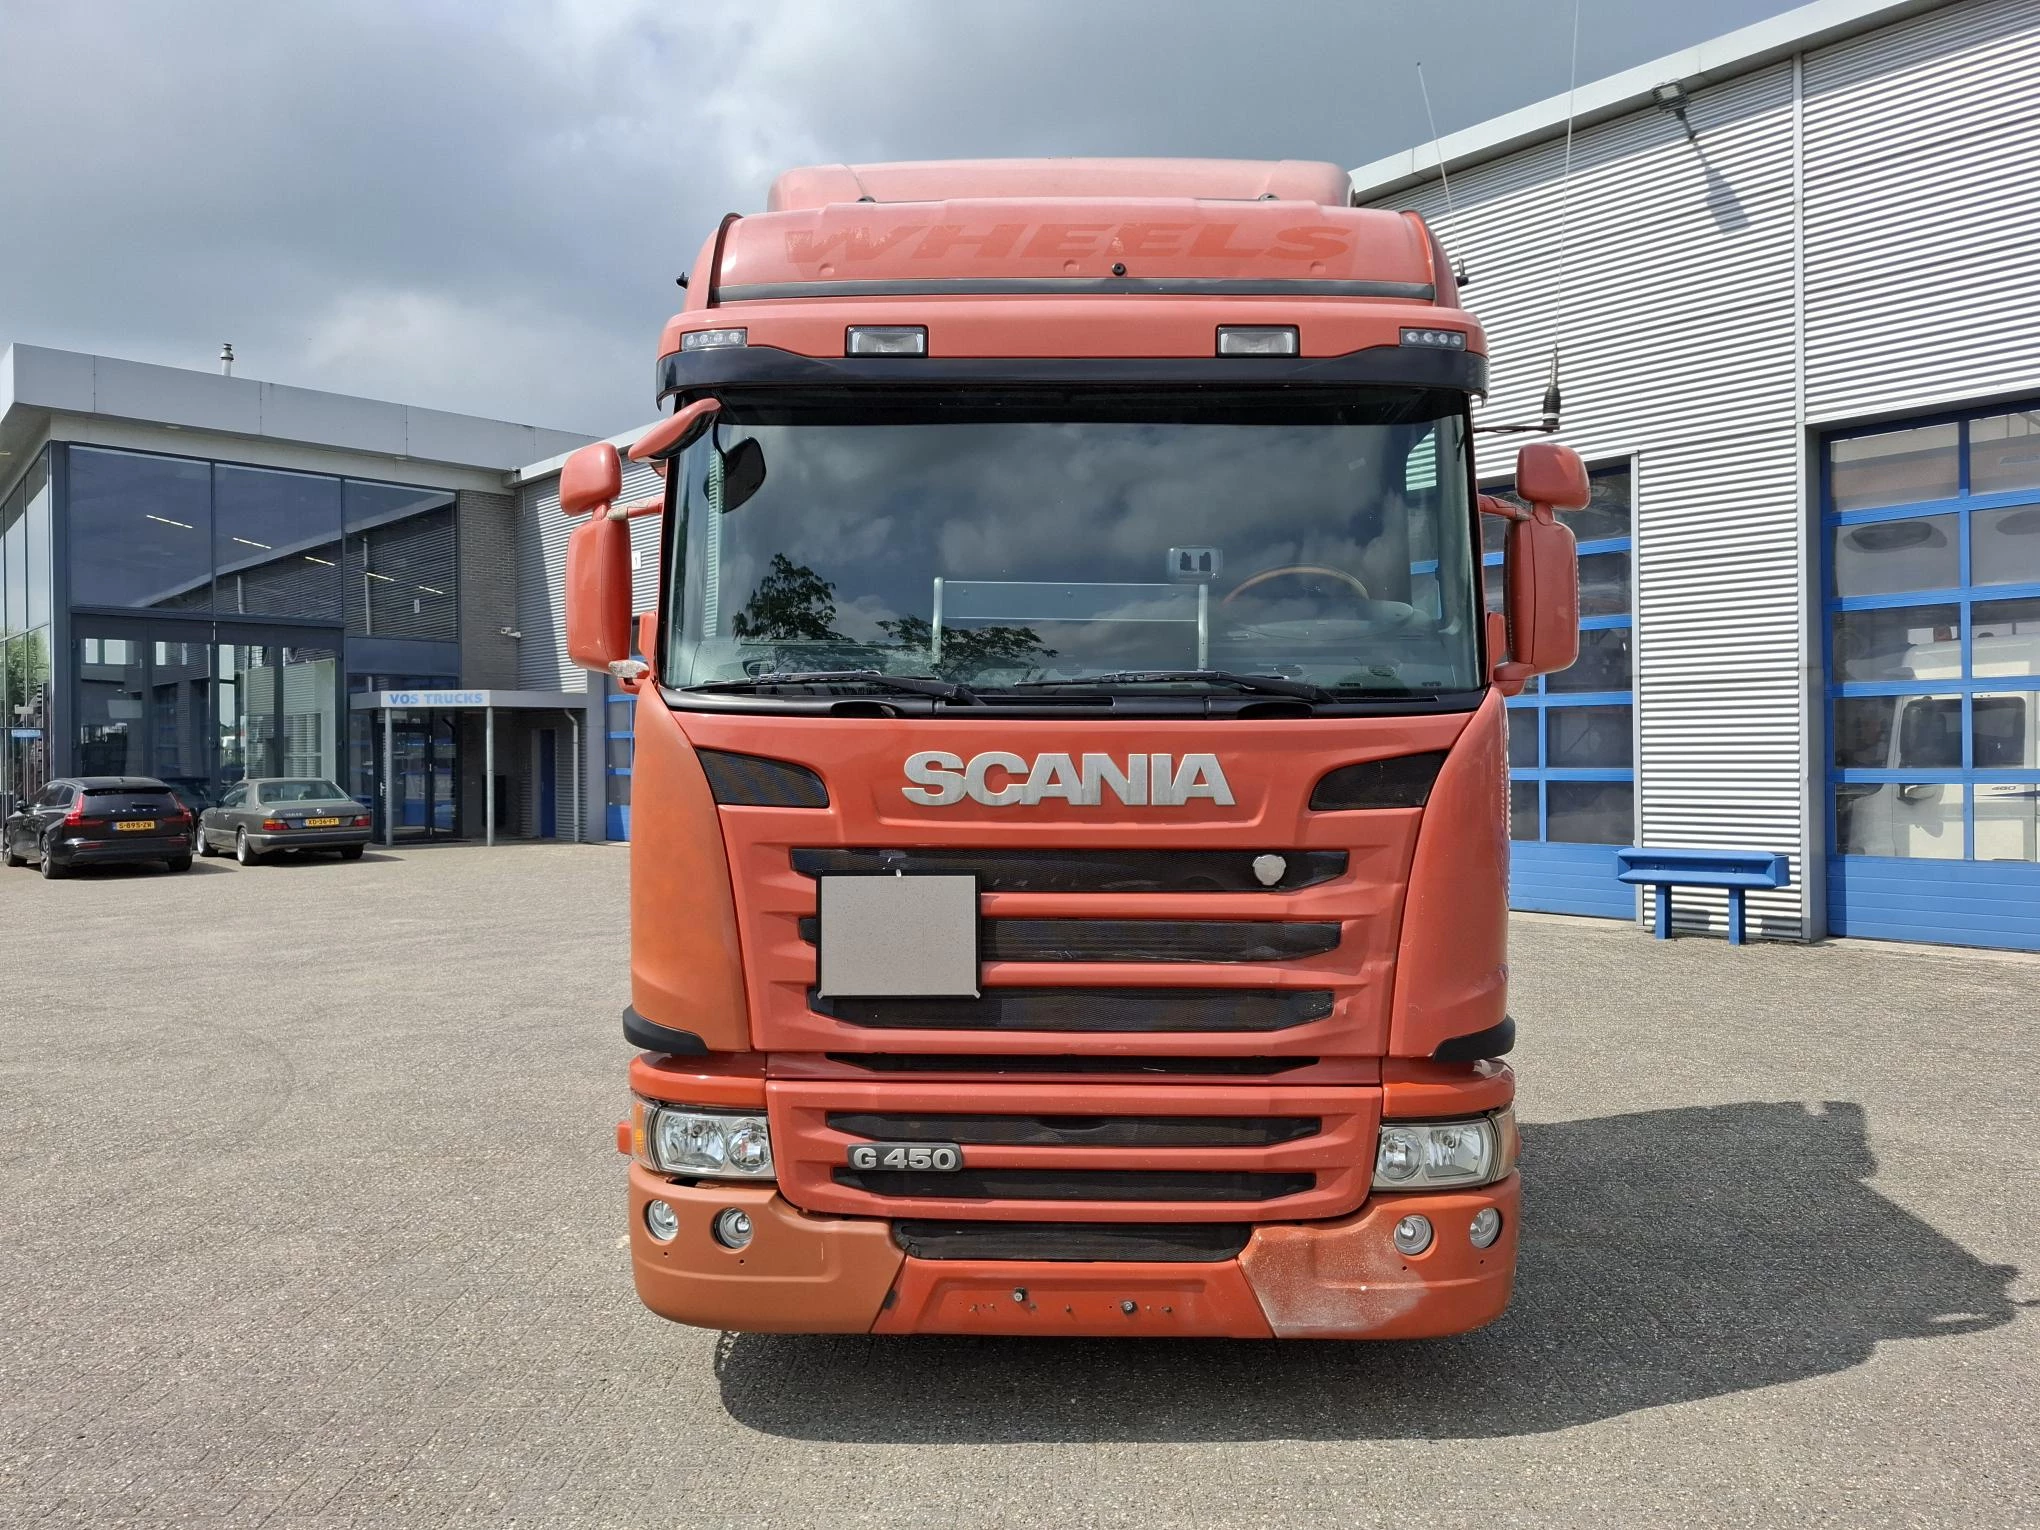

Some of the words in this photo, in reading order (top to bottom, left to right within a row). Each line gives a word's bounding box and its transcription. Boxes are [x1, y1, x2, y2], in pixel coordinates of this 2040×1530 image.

[785, 222, 1352, 264] WHEELS
[389, 693, 419, 705] VOS
[423, 692, 483, 705] TRUCKS
[902, 750, 1236, 806] SCANIA
[853, 1147, 877, 1169] G
[883, 1148, 957, 1170] 450
